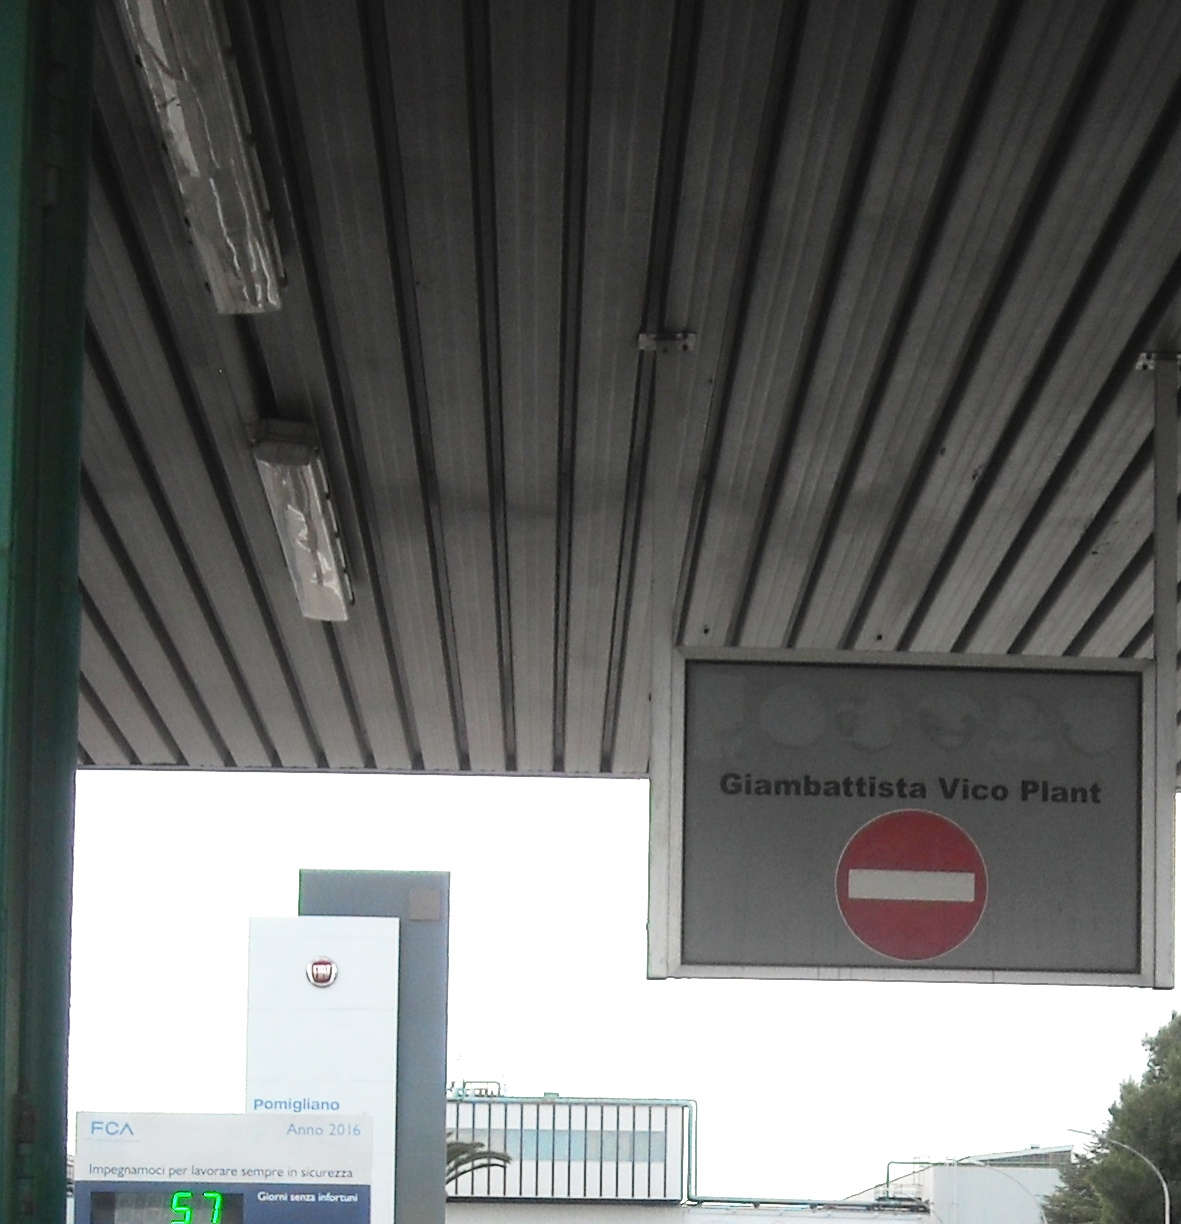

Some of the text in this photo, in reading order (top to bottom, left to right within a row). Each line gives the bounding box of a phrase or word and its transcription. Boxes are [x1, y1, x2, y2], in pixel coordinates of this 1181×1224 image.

[719, 772, 1102, 804] Giambattista Vico Plant
[253, 1098, 340, 1113] Pomigliano
[91, 1121, 134, 1136] FCA
[286, 1123, 361, 1137] Anno 2016
[89, 1163, 353, 1179] Impegnamoci per lavorare sempre in sicurezza
[257, 1191, 358, 1203] Giorni senza infortuni
